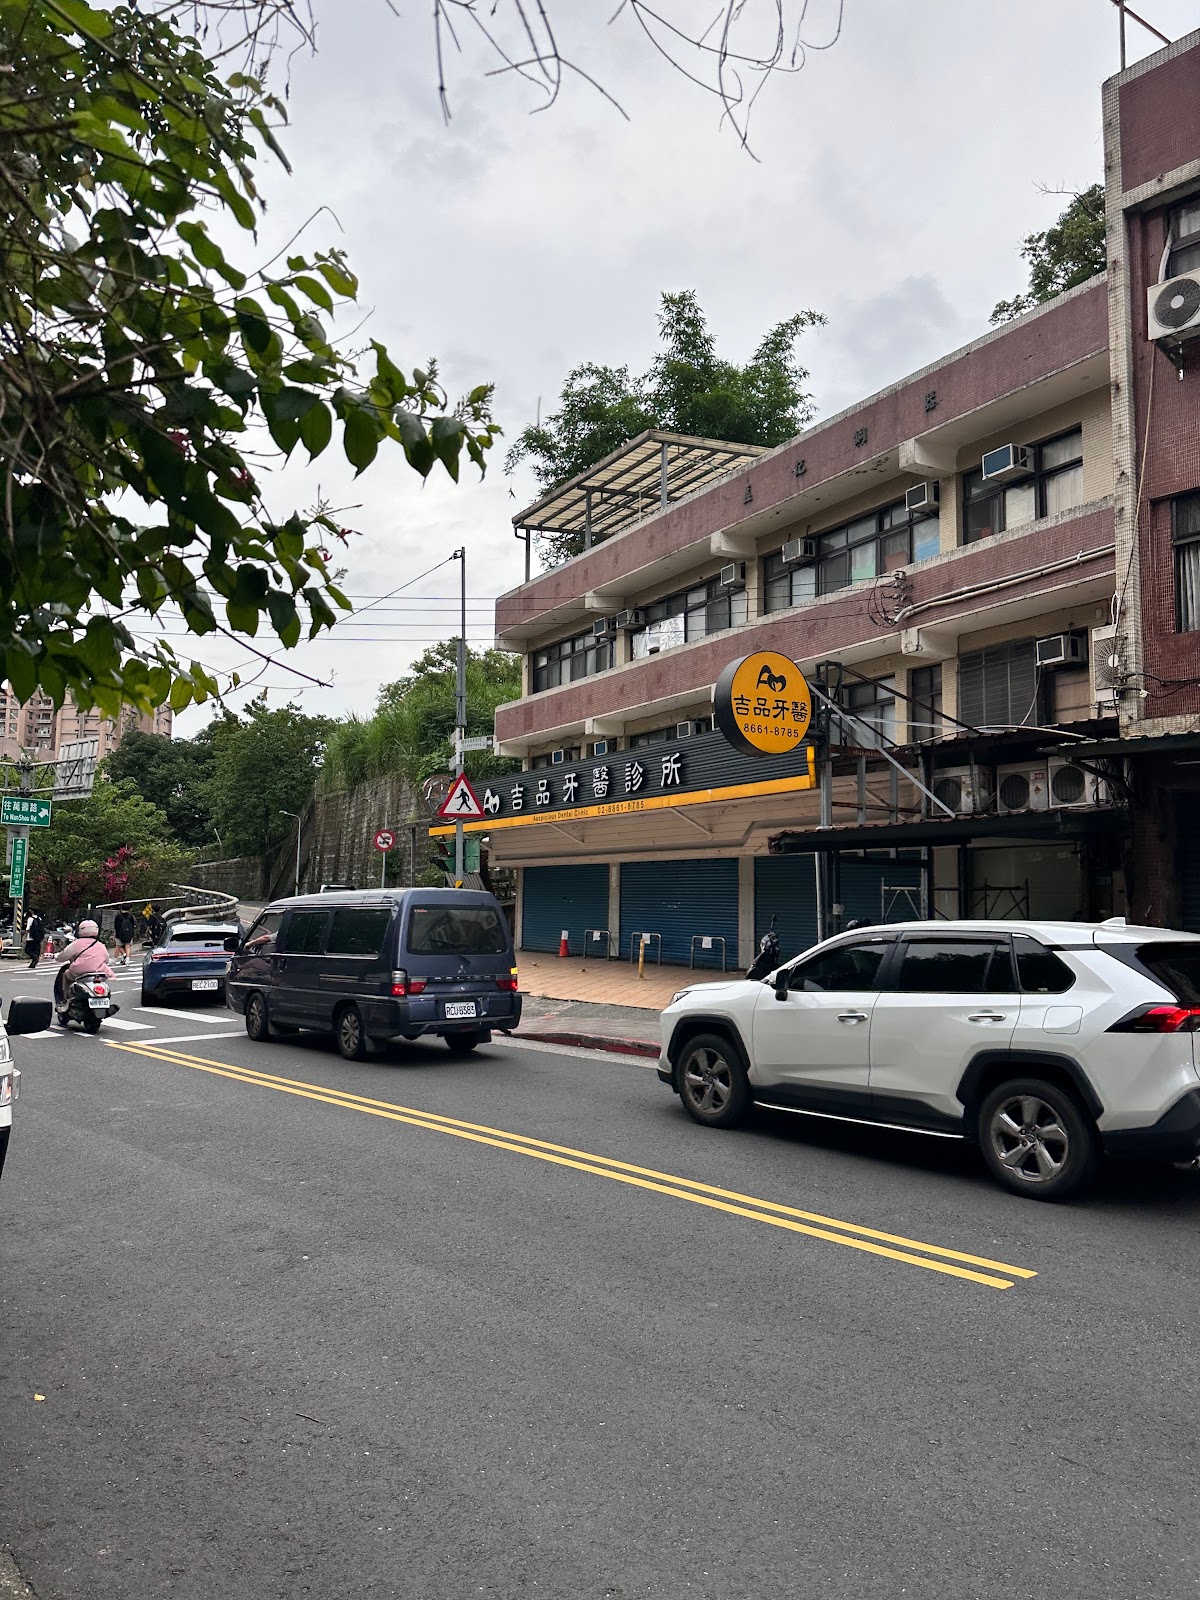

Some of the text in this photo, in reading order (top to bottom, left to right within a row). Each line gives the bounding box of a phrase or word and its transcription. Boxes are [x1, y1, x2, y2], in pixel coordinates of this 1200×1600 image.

[733, 694, 808, 723] 吉品牙醫
[743, 723, 799, 738] 8661-8785
[510, 752, 682, 810] 吉品牙醫診所
[4, 800, 38, 813] 往萬壽路
[557, 810, 573, 820] Dental
[574, 808, 589, 818] Clinic
